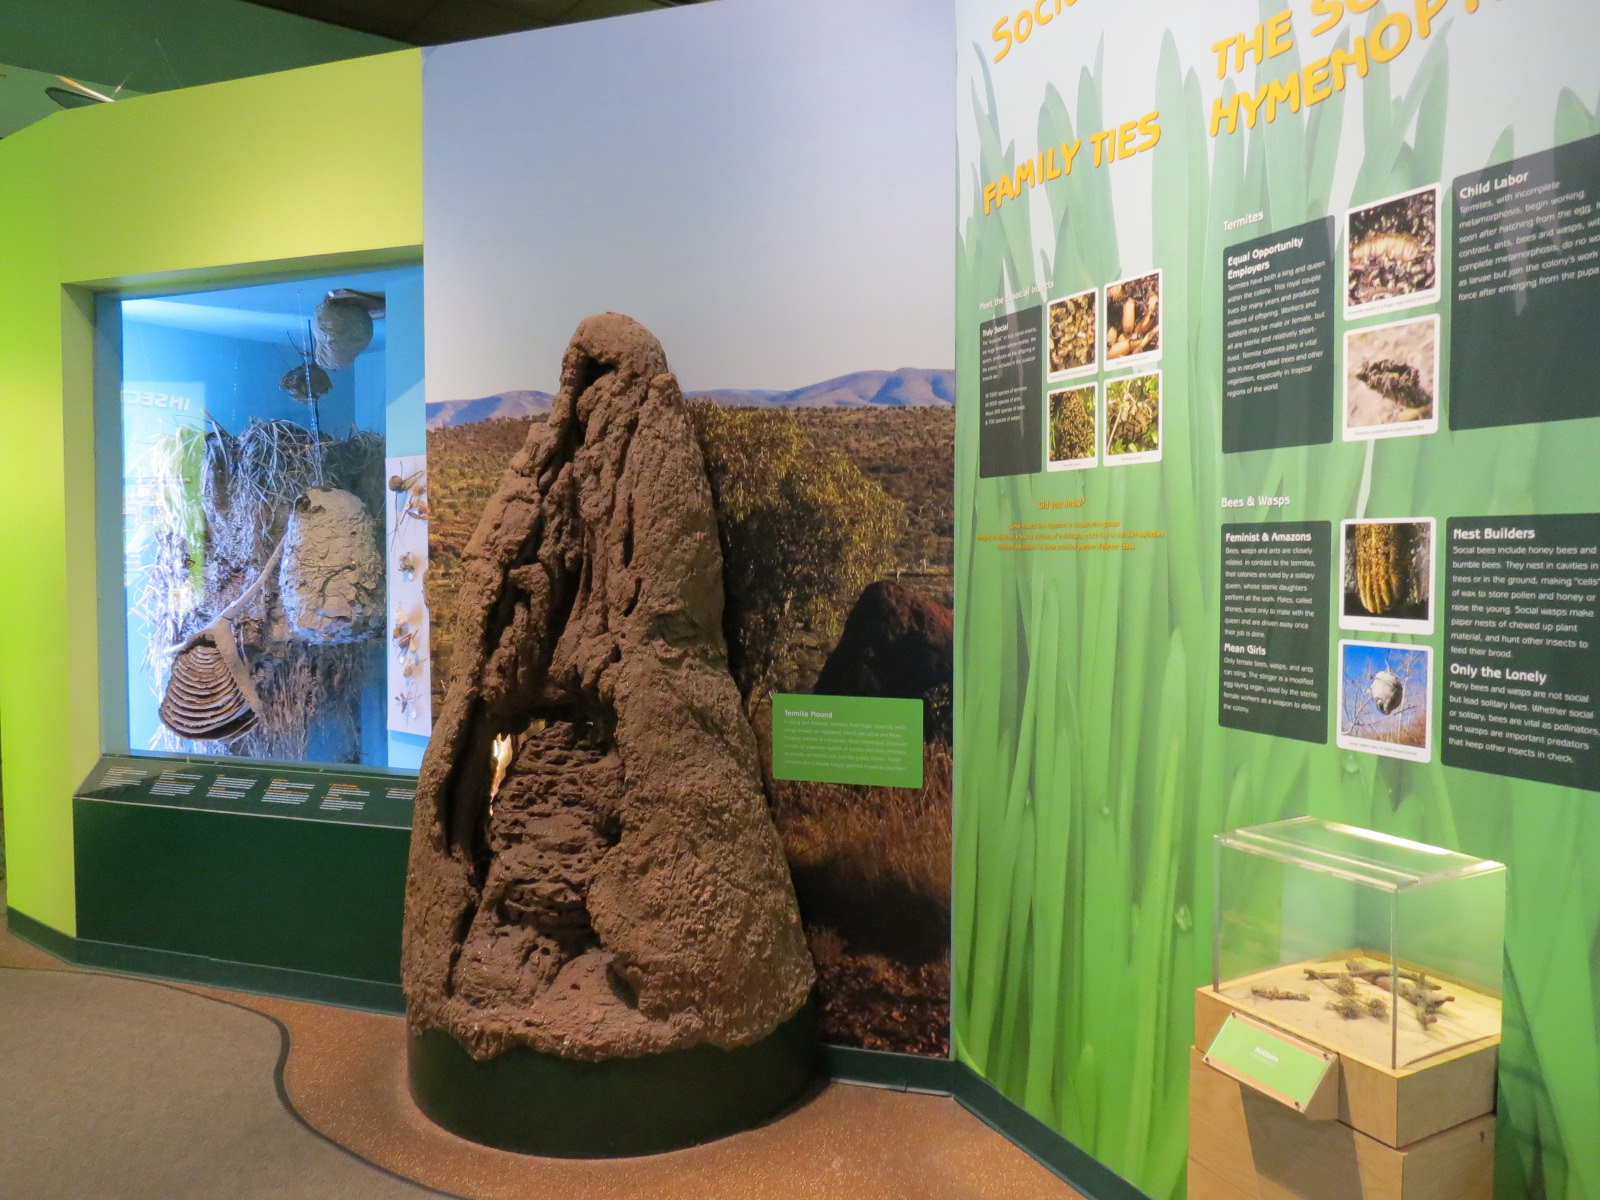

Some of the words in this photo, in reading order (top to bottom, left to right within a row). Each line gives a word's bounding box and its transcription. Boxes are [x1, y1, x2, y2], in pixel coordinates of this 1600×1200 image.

[1211, 9, 1293, 79] THE
[983, 139, 1081, 216] FAMILY
[1089, 110, 1161, 168] TIES
[1459, 180, 1490, 199] Child
[1494, 171, 1529, 190] Labor
[1495, 193, 1513, 204] with
[1515, 182, 1560, 199] incomplete
[1525, 200, 1549, 212] begin
[1550, 190, 1585, 206] working
[1223, 211, 1264, 231] Termites
[1459, 233, 1478, 244] soon
[1478, 228, 1498, 239] after
[1499, 219, 1534, 233] hatching
[1535, 214, 1555, 224] from
[1557, 209, 1572, 219] the
[1515, 234, 1537, 245] bees
[1538, 227, 1554, 239] and
[1227, 251, 1250, 266] Equal
[1252, 237, 1304, 260] Opportunity
[1458, 259, 1494, 272] complete
[1561, 240, 1574, 249] do
[1227, 261, 1270, 280] Employers
[1458, 279, 1468, 287] as
[1469, 274, 1492, 284] larvae
[1493, 270, 1507, 280] but
[1508, 267, 1524, 278] join
[1525, 264, 1540, 273] the
[1541, 255, 1576, 269] colony's
[1577, 250, 1599, 261] work
[1458, 292, 1477, 301] force
[1478, 288, 1497, 297] after
[1498, 279, 1537, 293] emerging
[1538, 275, 1559, 285] from
[1561, 272, 1576, 281] the
[1577, 267, 1600, 279] pupa
[994, 296, 1004, 306] the
[994, 322, 1009, 335] Social
[1221, 497, 1244, 508] Bees
[1246, 496, 1255, 506] &
[1258, 495, 1291, 507] Wasps
[1225, 532, 1260, 542] Feminist
[1261, 532, 1270, 542] &
[1271, 532, 1312, 542] Amazons
[1453, 528, 1481, 539] Nest
[1483, 527, 1536, 539] Builders
[1452, 546, 1475, 554] Social
[1476, 546, 1496, 554] bees
[1497, 546, 1527, 554] include
[1528, 546, 1554, 555] honey
[1555, 546, 1578, 555] bees
[1579, 546, 1597, 554] and
[1505, 561, 1524, 570] They
[1555, 562, 1589, 570] cavities
[1590, 562, 1599, 570] in
[1452, 575, 1472, 583] trees
[1492, 576, 1506, 584] the
[1540, 577, 1573, 587] making
[1451, 589, 1460, 597] of
[1477, 590, 1486, 598] to
[1510, 591, 1536, 600] pollen
[1537, 592, 1554, 600] and
[1555, 592, 1584, 603] honey
[1451, 604, 1470, 612] raise
[1471, 604, 1484, 612] the
[1514, 605, 1539, 615] Social
[1540, 608, 1568, 617] wasps
[1569, 609, 1594, 617] make
[1450, 618, 1472, 626] paper
[1498, 620, 1507, 628] of
[1508, 621, 1540, 630] chewed
[1542, 624, 1554, 632] up
[1555, 623, 1578, 632] plant
[1224, 643, 1245, 653] Mean
[1246, 645, 1267, 656] Girls
[1450, 645, 1468, 654] feed
[1501, 635, 1520, 644] hunt
[1521, 637, 1544, 645] other
[1545, 638, 1577, 648] insects
[1579, 640, 1589, 649] to
[1450, 663, 1478, 679] Only
[1480, 666, 1502, 679] the
[1505, 668, 1547, 685] Lonely
[1449, 680, 1469, 691] Many
[1470, 683, 1489, 692] bees
[1490, 686, 1506, 694] and
[1506, 688, 1532, 697] wasps
[1548, 692, 1563, 700] not
[1564, 694, 1590, 703] social
[784, 709, 809, 718] Termite
[810, 710, 833, 719] Mound
[1449, 695, 1462, 703] but
[1463, 696, 1479, 705] lead
[1480, 699, 1508, 710] solitary
[1531, 704, 1567, 716] Whether
[1568, 710, 1594, 719] social
[1488, 714, 1508, 724] bees
[1508, 718, 1523, 726] are
[1523, 719, 1540, 727] vital
[1448, 724, 1463, 732] and
[1464, 726, 1489, 736] wasps
[1490, 730, 1503, 738] are
[1505, 732, 1545, 743] important
[1546, 738, 1590, 750] predators
[1448, 737, 1464, 746] that
[1465, 739, 1484, 750] keep
[1485, 744, 1506, 752] other
[1507, 747, 1536, 757] insects
